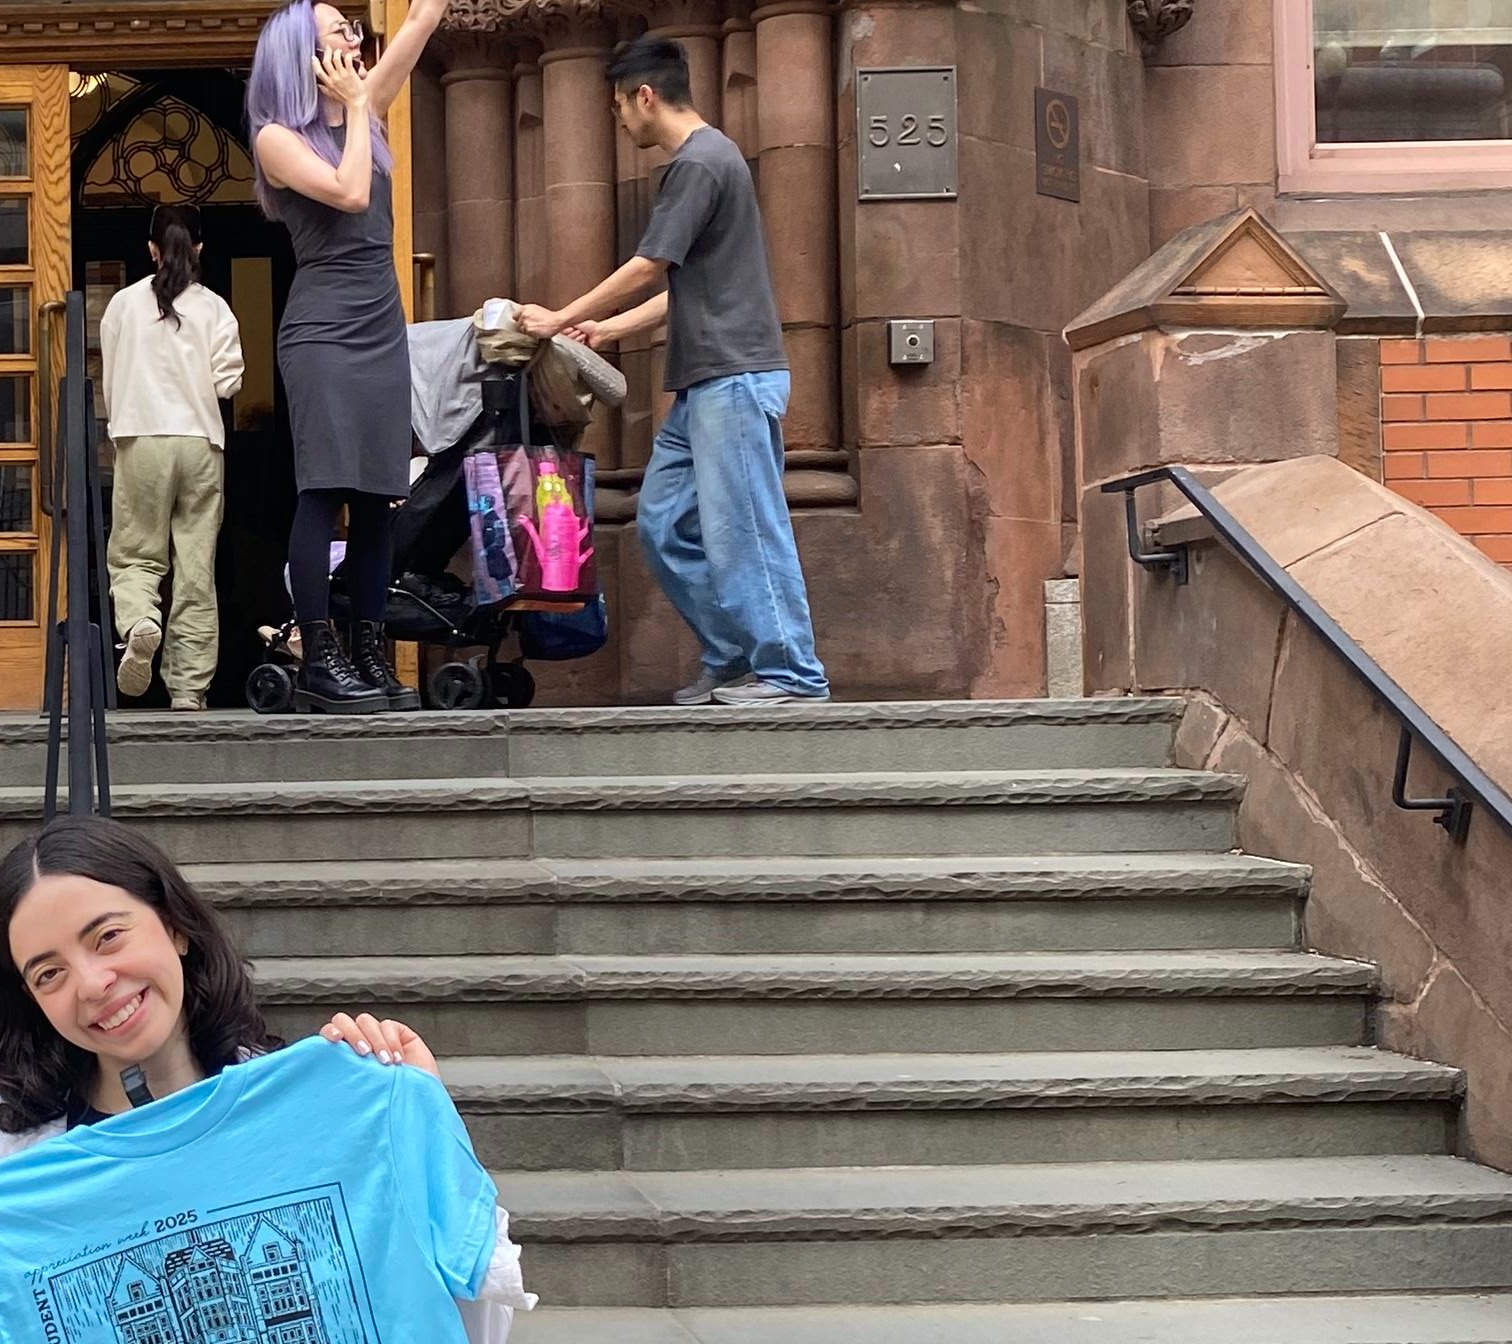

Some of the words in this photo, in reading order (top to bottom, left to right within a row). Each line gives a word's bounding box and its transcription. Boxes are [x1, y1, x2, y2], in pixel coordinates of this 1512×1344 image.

[868, 113, 948, 148] 525
[23, 1242, 113, 1286] appreciation
[117, 1220, 151, 1246] week
[154, 1209, 199, 1234] 2025
